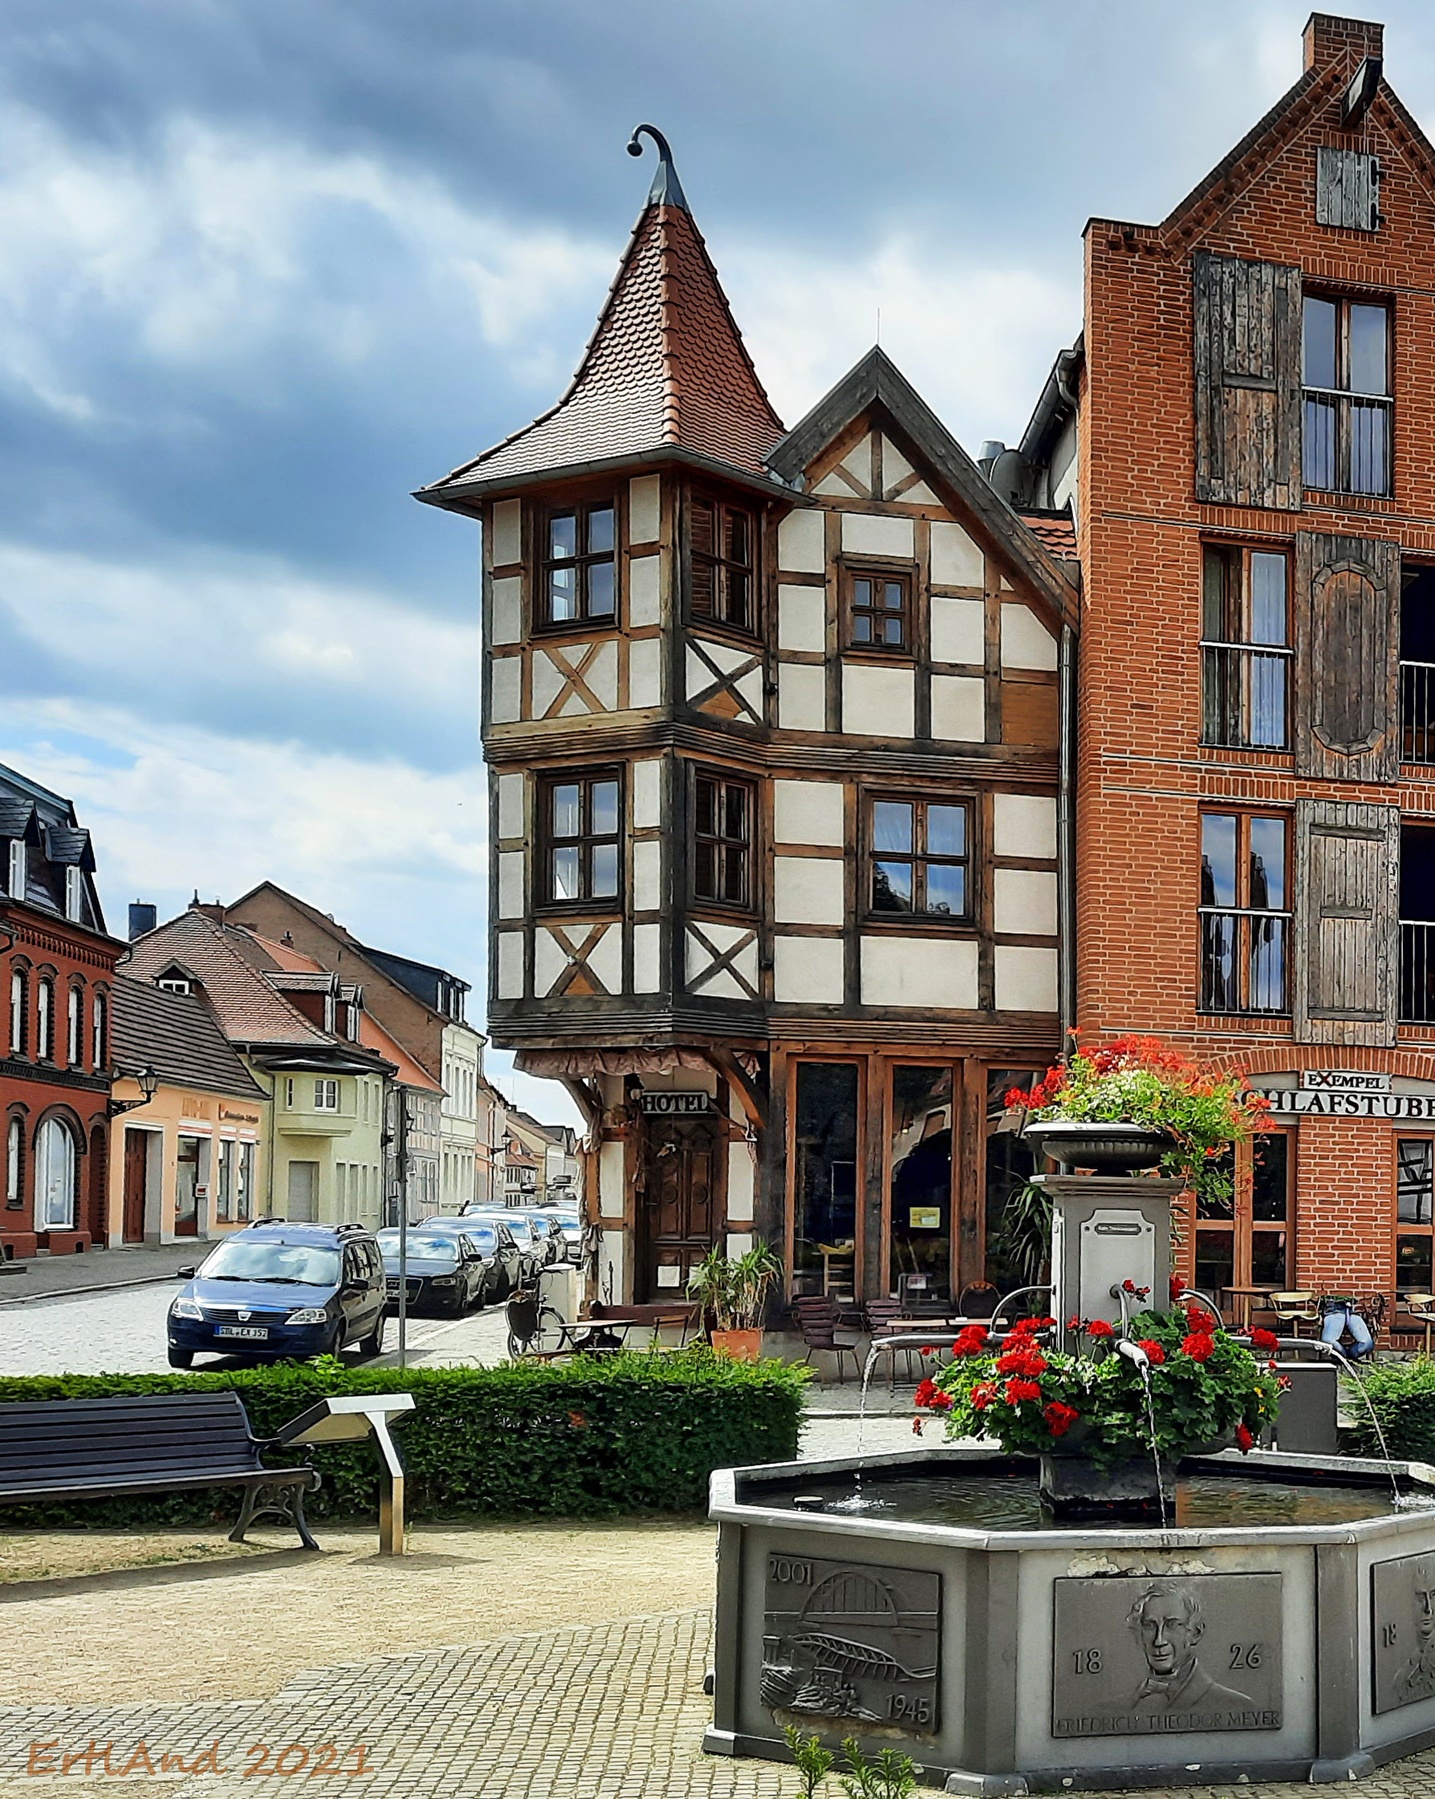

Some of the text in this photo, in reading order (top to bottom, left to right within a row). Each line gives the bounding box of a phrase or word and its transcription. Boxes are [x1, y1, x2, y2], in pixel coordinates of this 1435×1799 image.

[1308, 1071, 1385, 1090] EXEMPEL
[641, 1094, 713, 1112] HOTEL
[769, 1558, 813, 1585] 2001
[1073, 1643, 1262, 1675] 18 26
[886, 1694, 930, 1723] 1945
[1149, 1713, 1222, 1730] THEODOR
[1227, 1710, 1280, 1727] MEYER
